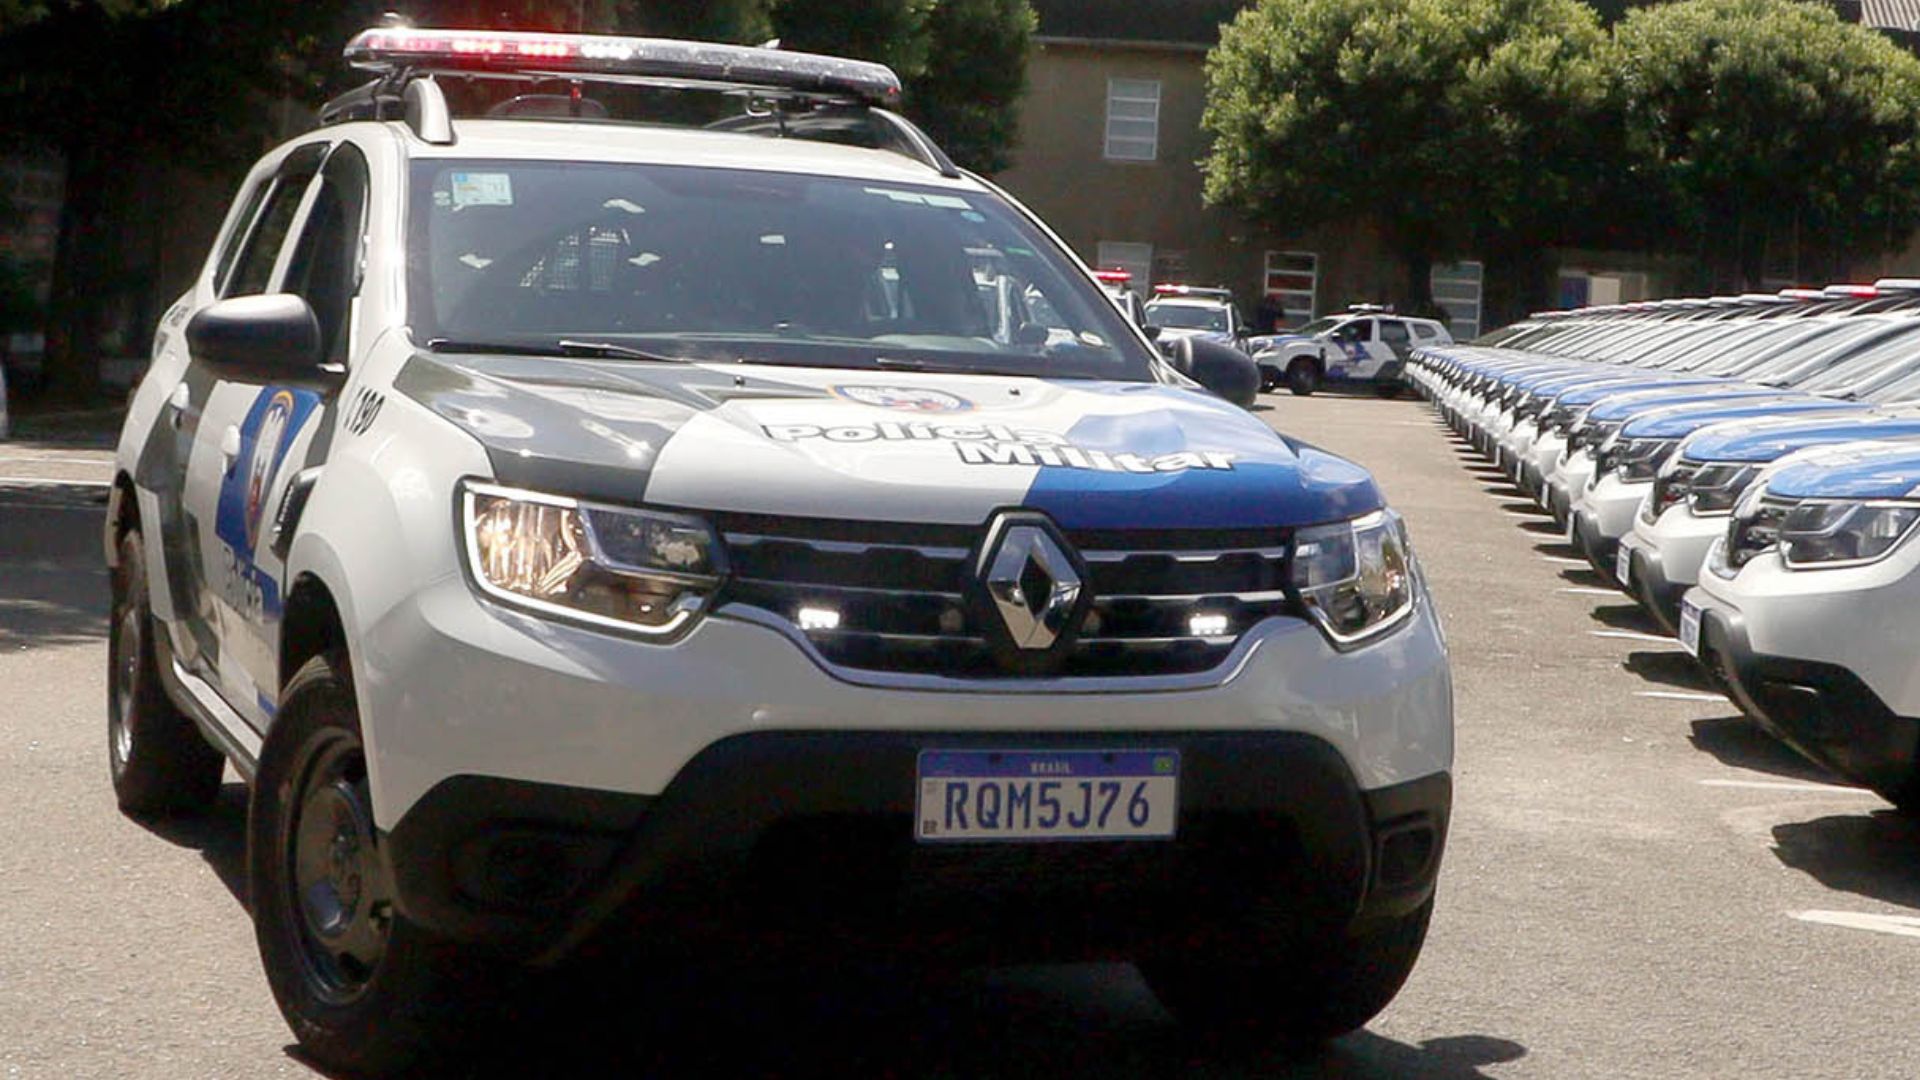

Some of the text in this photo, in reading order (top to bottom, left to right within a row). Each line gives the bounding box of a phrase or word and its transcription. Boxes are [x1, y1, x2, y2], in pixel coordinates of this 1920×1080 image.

[350, 388, 386, 436] 190
[952, 440, 1236, 474] Militar
[1029, 760, 1073, 774] BRASIL
[945, 781, 1151, 830] RQM5J76
